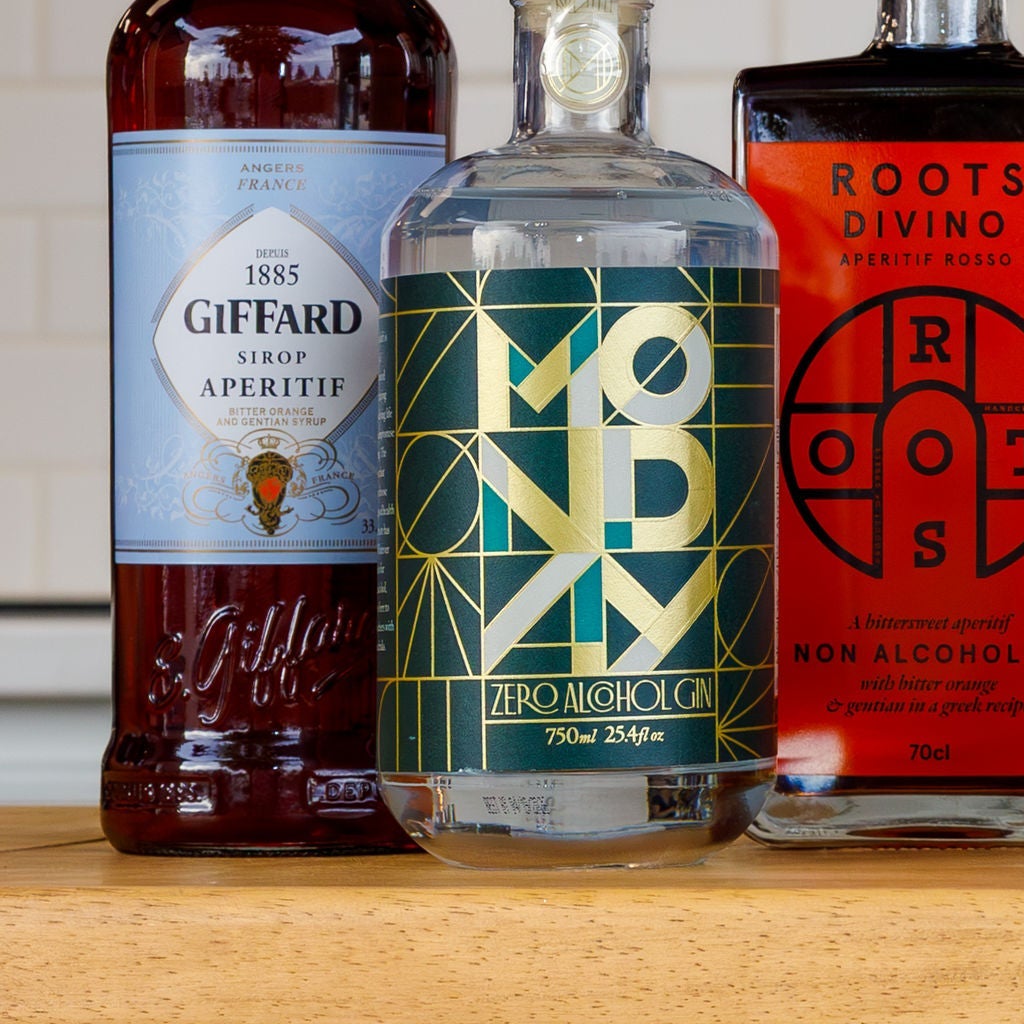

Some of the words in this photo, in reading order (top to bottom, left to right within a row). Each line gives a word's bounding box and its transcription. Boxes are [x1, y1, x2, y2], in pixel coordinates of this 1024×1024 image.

[240, 163, 305, 173] ANGERS
[237, 178, 307, 191] FRANCE
[831, 163, 1024, 196] ROOTS
[844, 210, 1005, 239] DIVINO
[256, 249, 289, 259] DEPUIS
[840, 253, 933, 266] APERITIF
[945, 253, 1012, 266] ROSSO
[245, 264, 300, 286] 1885
[184, 299, 362, 334] GIFFARD
[237, 350, 307, 365] SIROP
[200, 377, 346, 397] APERITIF
[216, 417, 238, 426] AND
[241, 417, 289, 426] GENTIAN
[292, 417, 327, 426] SYRUP
[229, 407, 266, 416] BITTER
[269, 407, 314, 416] ORANGE
[848, 614, 860, 630] A
[865, 613, 949, 630] bittersweet
[952, 614, 1014, 635] aperitif
[794, 644, 856, 664] NON
[860, 674, 894, 691] with
[897, 674, 941, 691] bitter
[946, 680, 998, 696] orange
[490, 682, 559, 716] ZERO
[564, 679, 672, 714] ALCOHOL
[674, 677, 711, 710] GIN
[826, 698, 842, 712] &
[844, 698, 907, 716] gentian
[908, 698, 925, 712] in
[928, 702, 938, 712] a
[939, 697, 982, 717] greek
[545, 727, 597, 745] 750ml
[909, 744, 950, 760] 70cl
